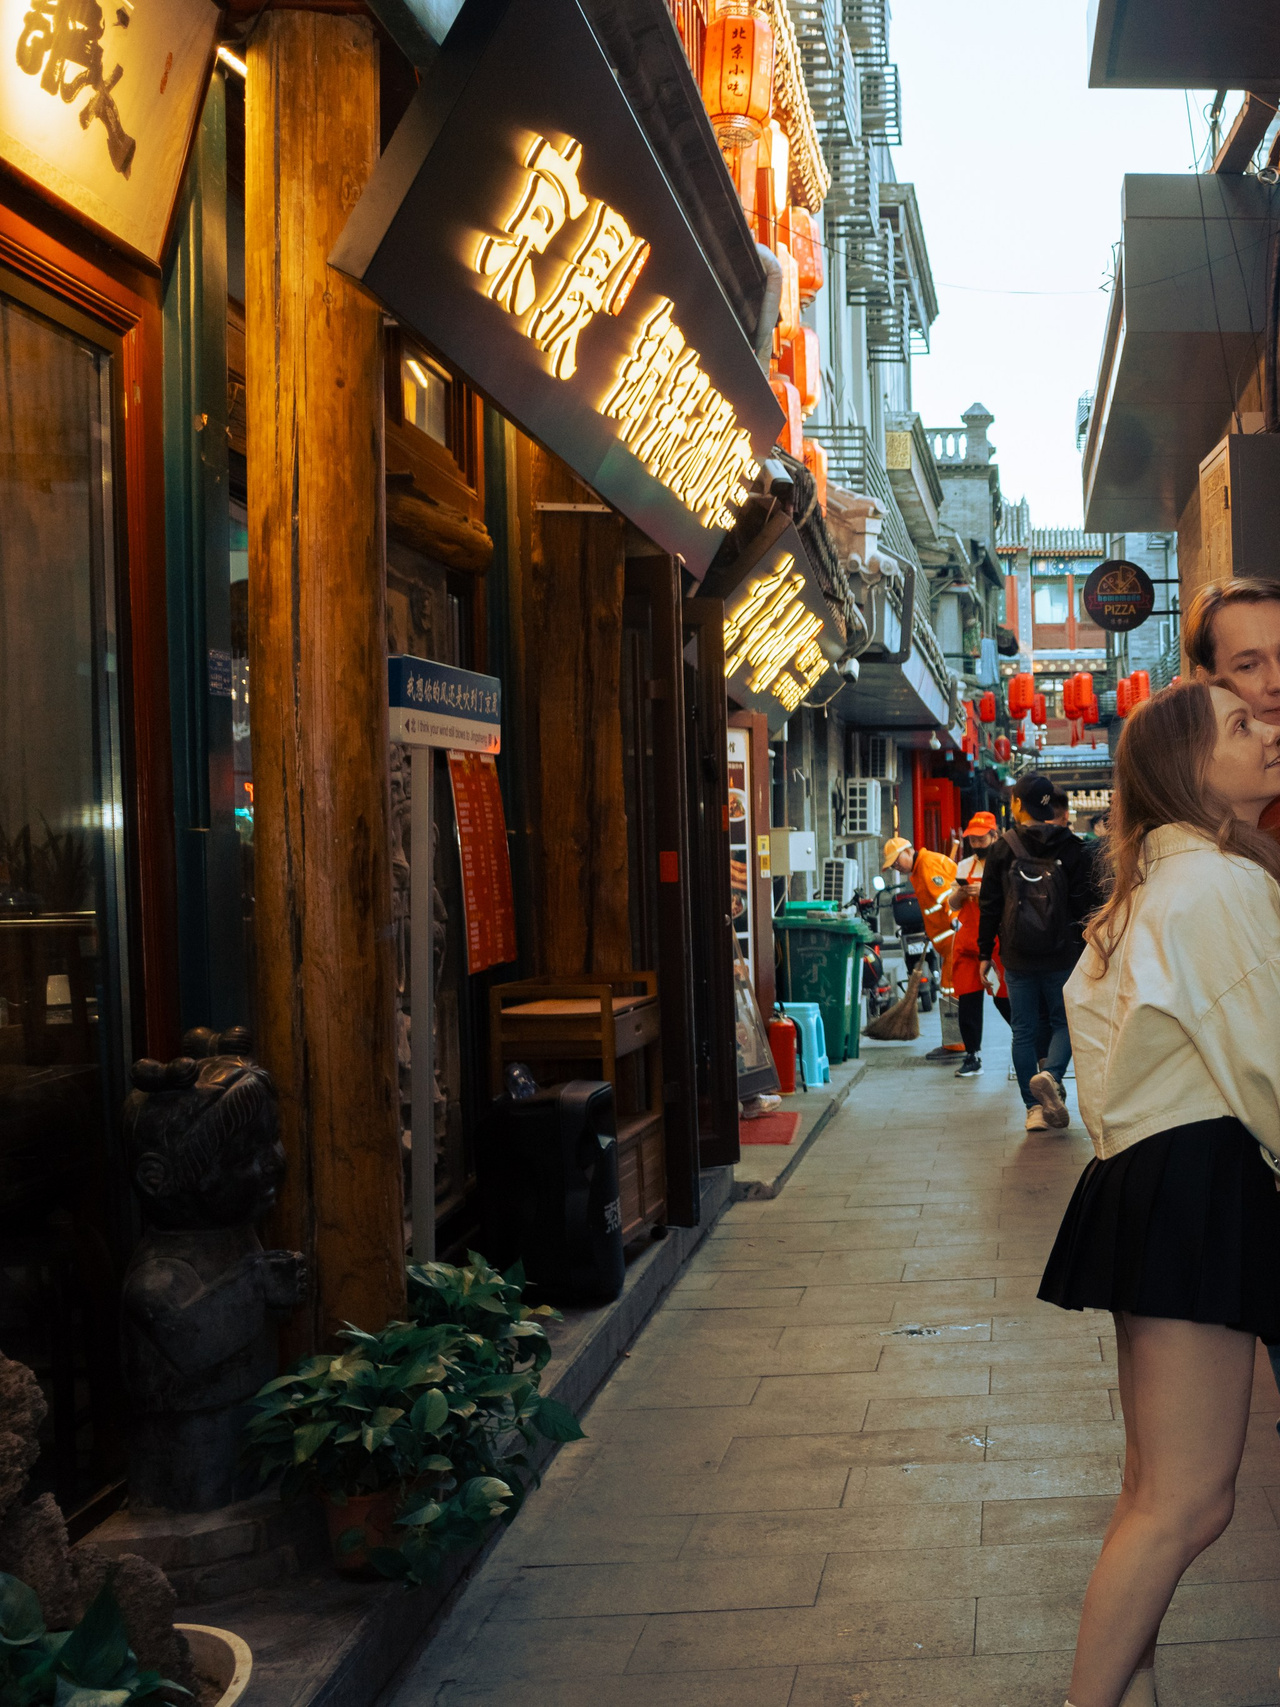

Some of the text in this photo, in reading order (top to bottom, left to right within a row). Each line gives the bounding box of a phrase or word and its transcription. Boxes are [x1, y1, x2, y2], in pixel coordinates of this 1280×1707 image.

[727, 26, 747, 97] 北京小吃
[475, 135, 636, 382] 京晟
[1097, 594, 1141, 602] homemade
[1104, 604, 1137, 615] PIZZA
[406, 670, 499, 717] 我想你的风还是吹到了京晟
[430, 724, 439, 737] your
[439, 725, 448, 737] wind
